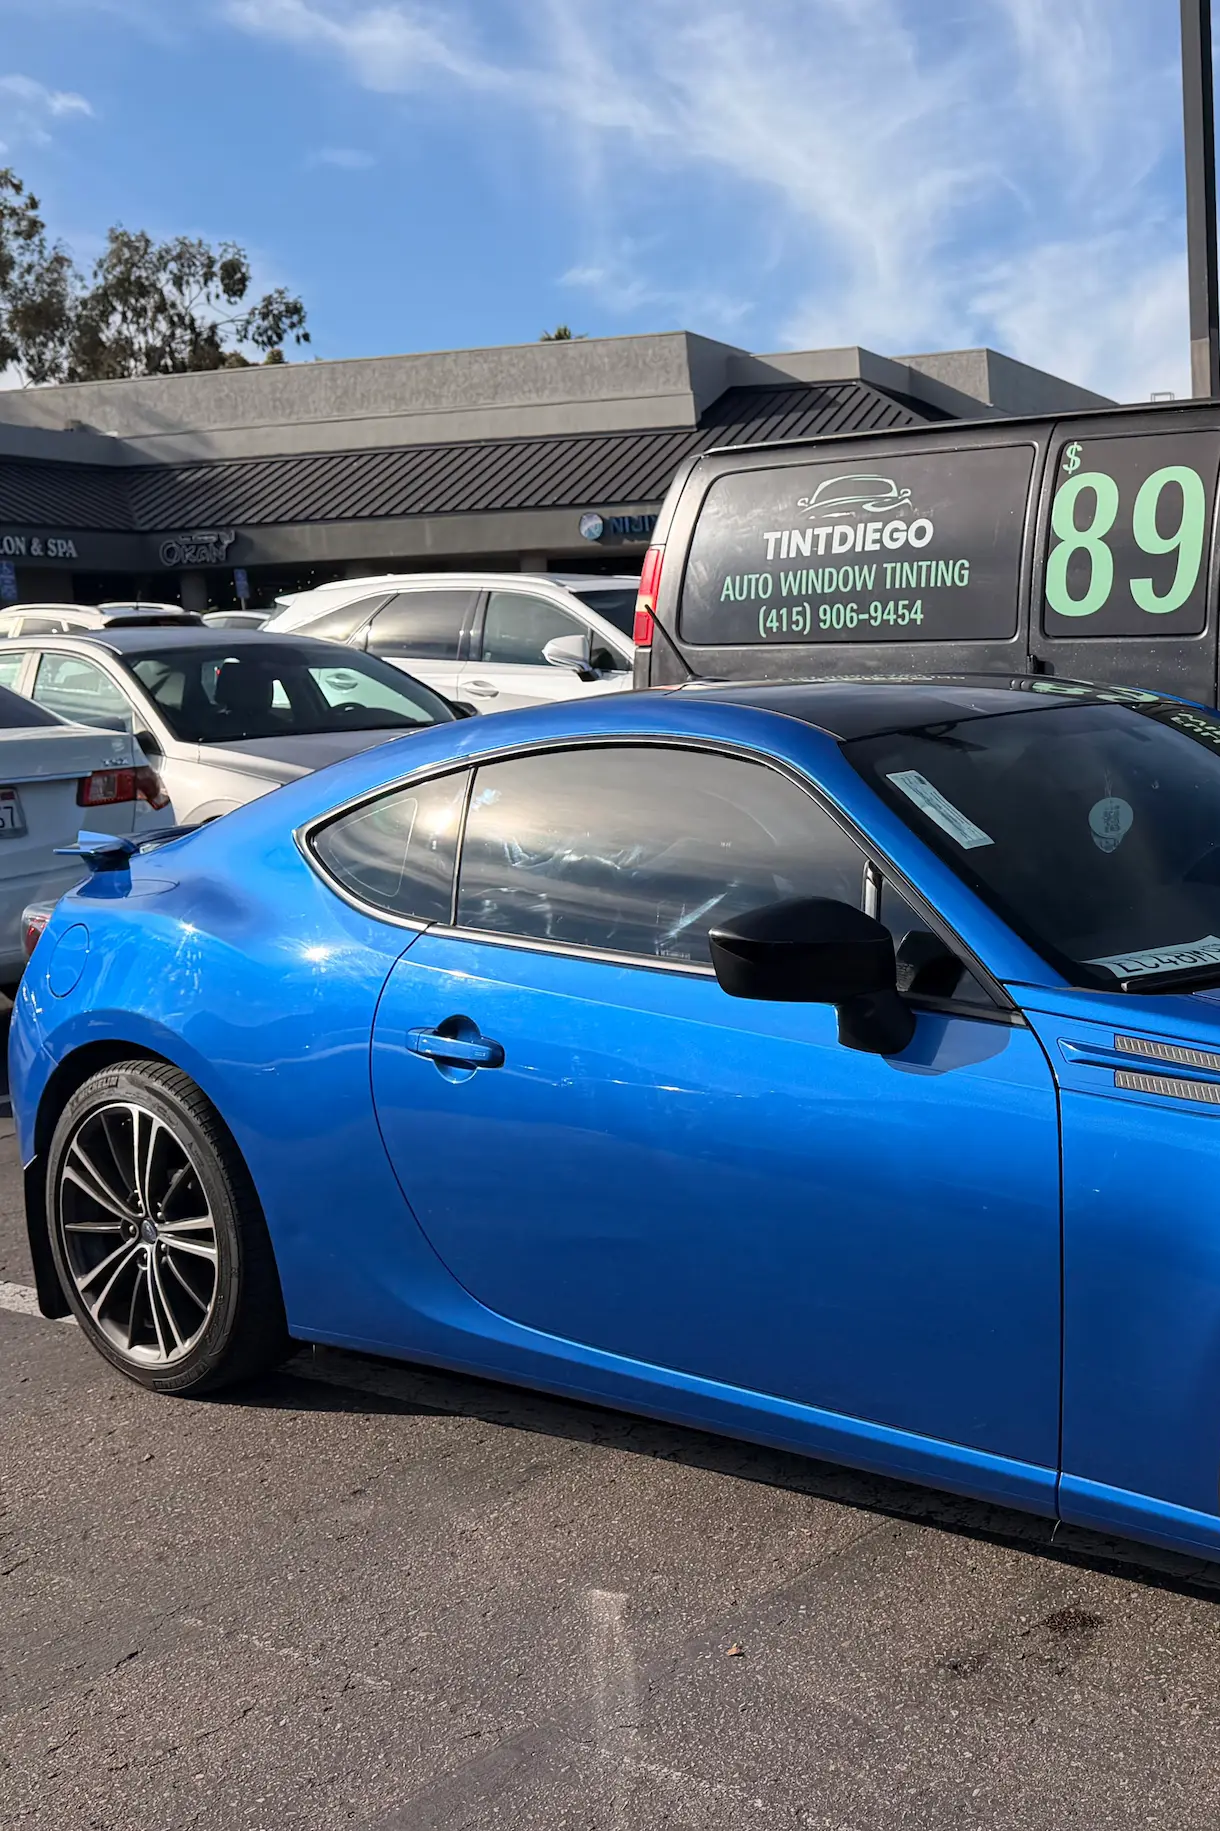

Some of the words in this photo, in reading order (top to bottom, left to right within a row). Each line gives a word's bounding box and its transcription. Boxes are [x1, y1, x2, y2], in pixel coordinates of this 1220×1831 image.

[47, 538, 78, 558] SPA
[763, 517, 934, 562] TINTDIEGO
[719, 571, 774, 603] AUTO
[779, 565, 876, 597] WINDOW
[885, 559, 970, 590] TINTING
[758, 606, 812, 637] (415)
[818, 599, 923, 630] 906-9454
